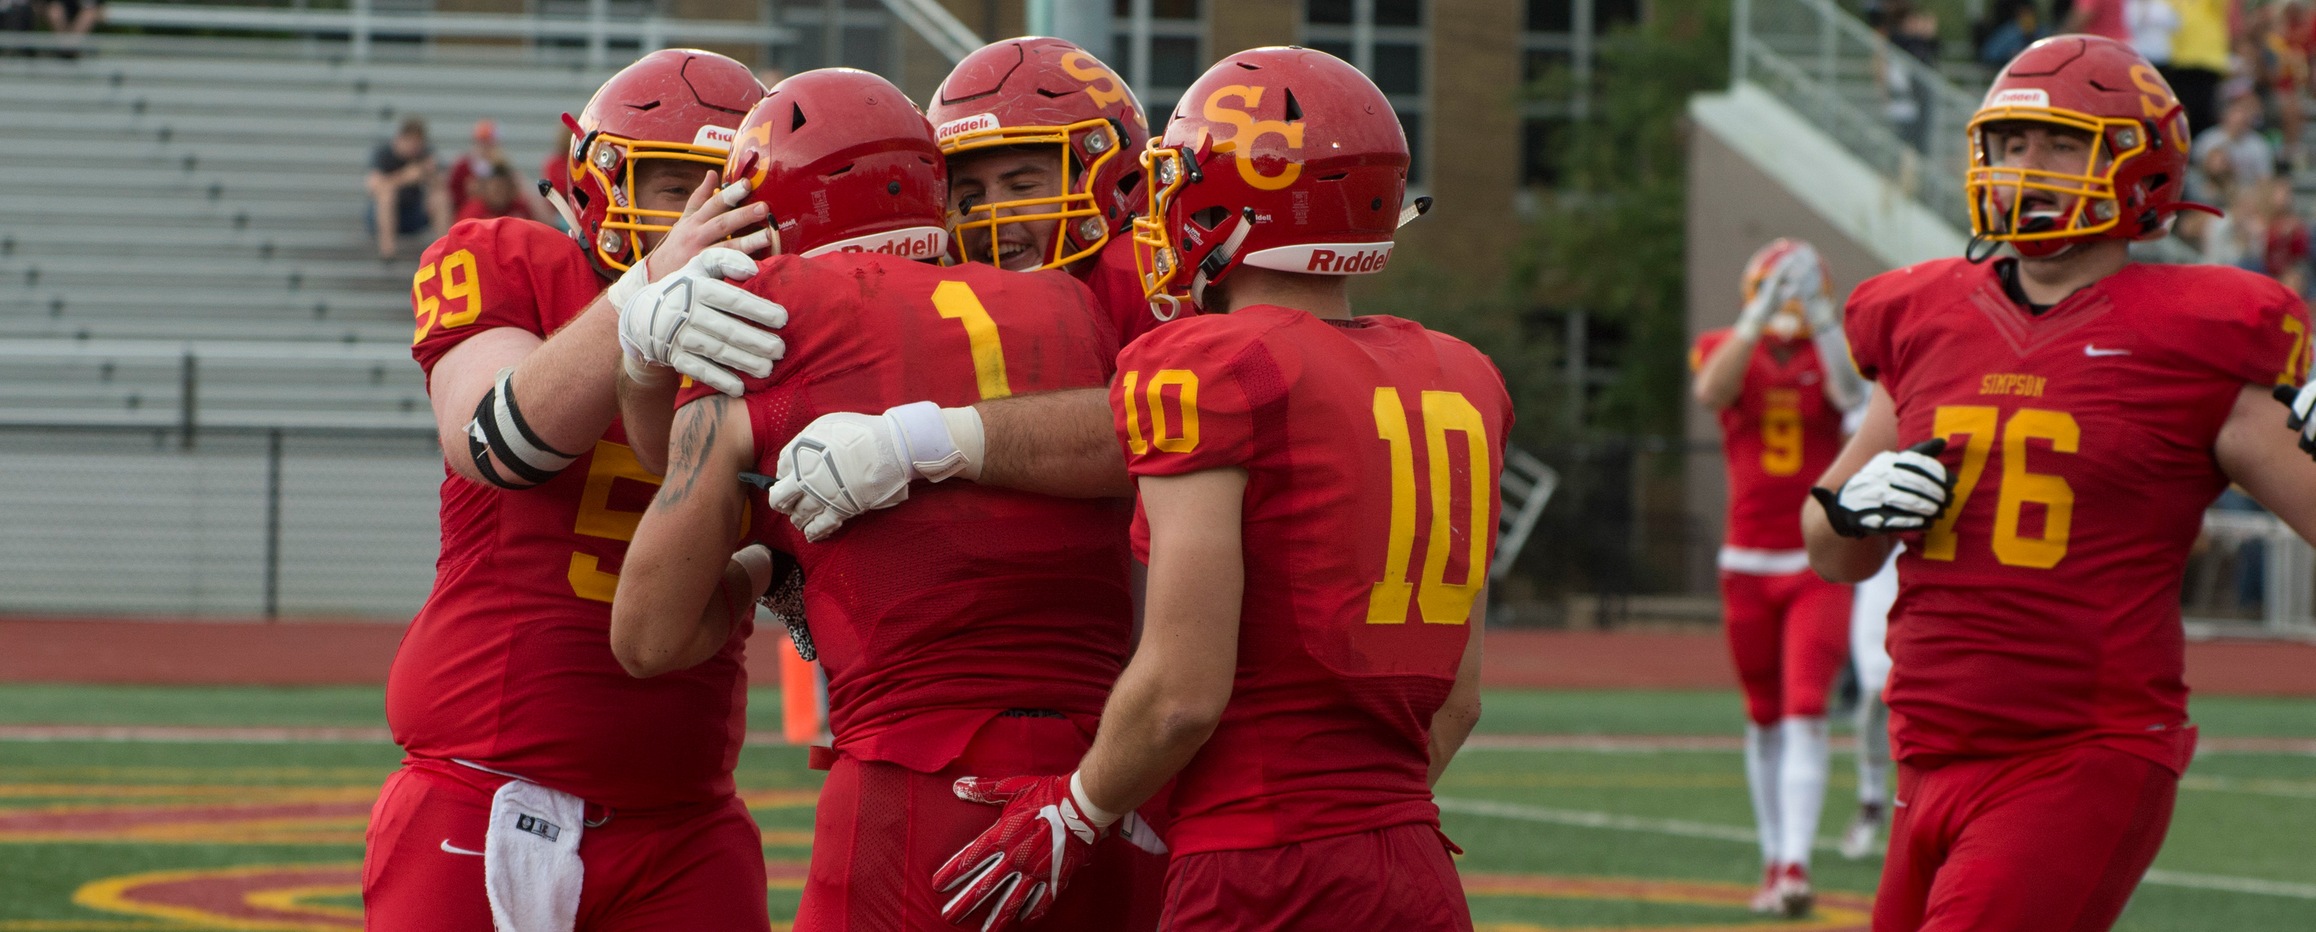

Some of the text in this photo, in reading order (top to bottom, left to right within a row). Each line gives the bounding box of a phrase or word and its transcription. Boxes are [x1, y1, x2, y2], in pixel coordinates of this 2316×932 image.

[1196, 85, 1305, 190] SC
[841, 232, 939, 257] ddell
[1307, 248, 1391, 272] Riddel
[413, 248, 481, 346] 59
[931, 280, 1012, 400] 1
[1123, 369, 1199, 455] 10
[1979, 373, 2047, 397] SIMPSON
[1760, 407, 1804, 476] 9
[1923, 406, 2080, 569] 76
[1366, 387, 1490, 624] 10
